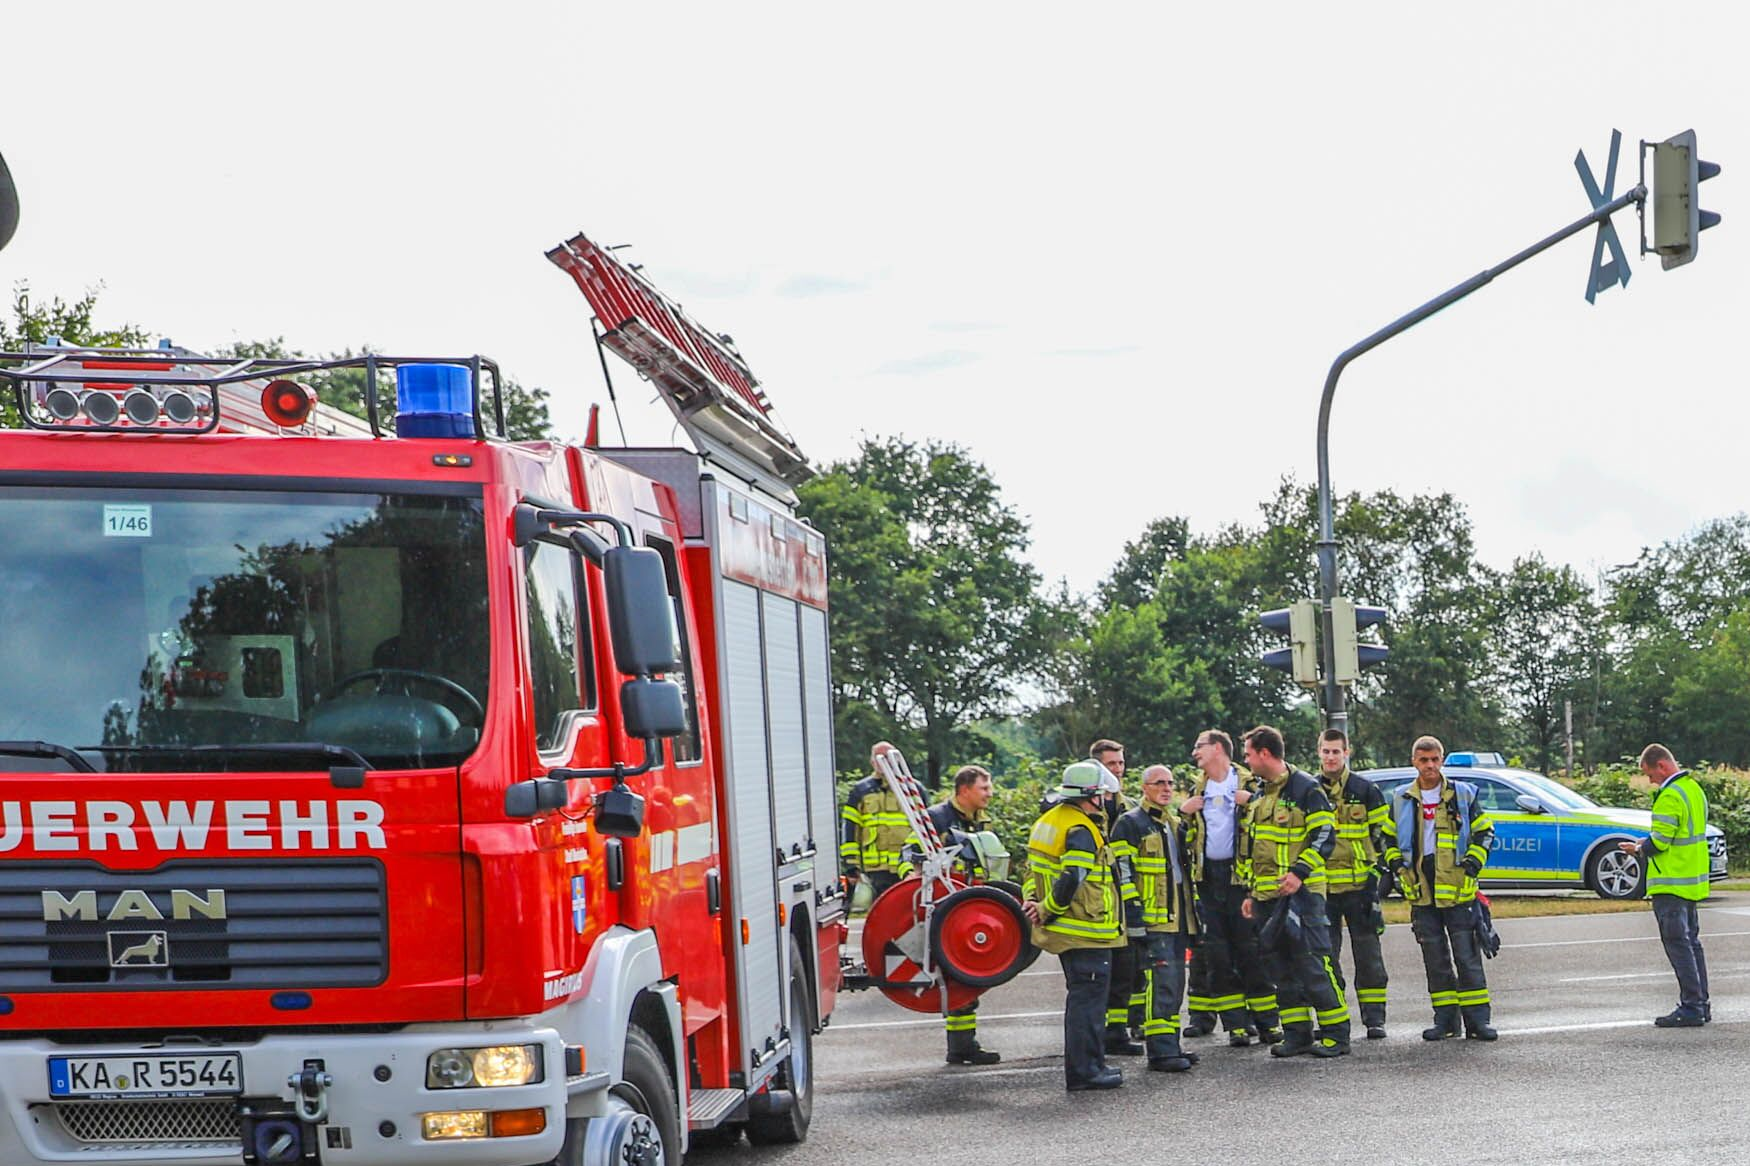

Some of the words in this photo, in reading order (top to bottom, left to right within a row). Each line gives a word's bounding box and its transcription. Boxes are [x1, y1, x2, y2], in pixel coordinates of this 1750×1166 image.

[109, 516, 148, 531] 1/46
[1491, 837, 1542, 852] OLIZEI
[41, 888, 227, 922] MAN
[71, 1062, 111, 1090] KA
[133, 1061, 152, 1088] R
[160, 1059, 236, 1087] 5544
